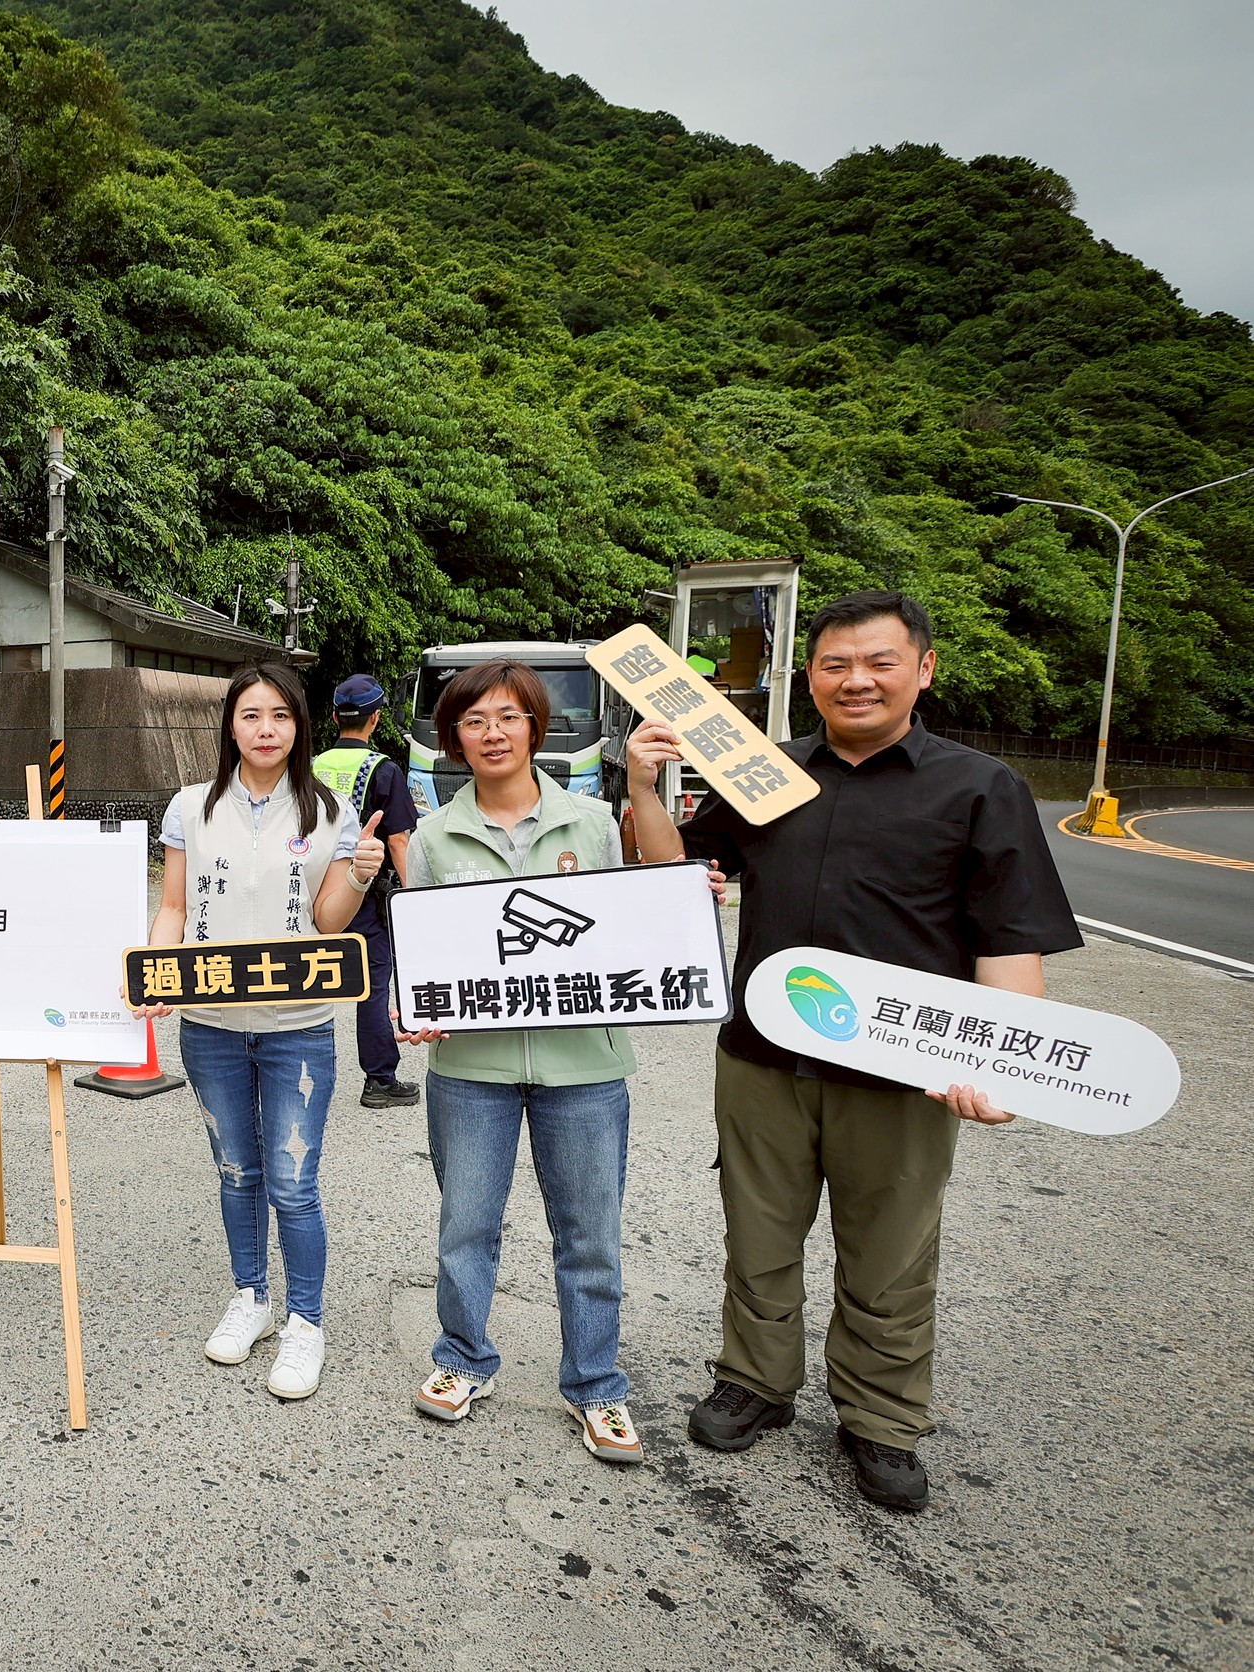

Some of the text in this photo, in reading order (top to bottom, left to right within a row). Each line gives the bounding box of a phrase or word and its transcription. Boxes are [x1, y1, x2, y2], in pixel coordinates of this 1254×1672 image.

[609, 644, 790, 804] 智慧監控
[215, 856, 229, 895] 秘書
[455, 860, 477, 870] 主任
[286, 860, 303, 938] 宜蘭縣議
[142, 948, 345, 998] 過境土方
[411, 965, 714, 1022] 車牌辨識系統
[68, 1011, 120, 1020] 宜蘭縣政府
[871, 996, 1093, 1072] 宜蘭縣政府
[866, 1024, 1133, 1107] Yilan County Government
